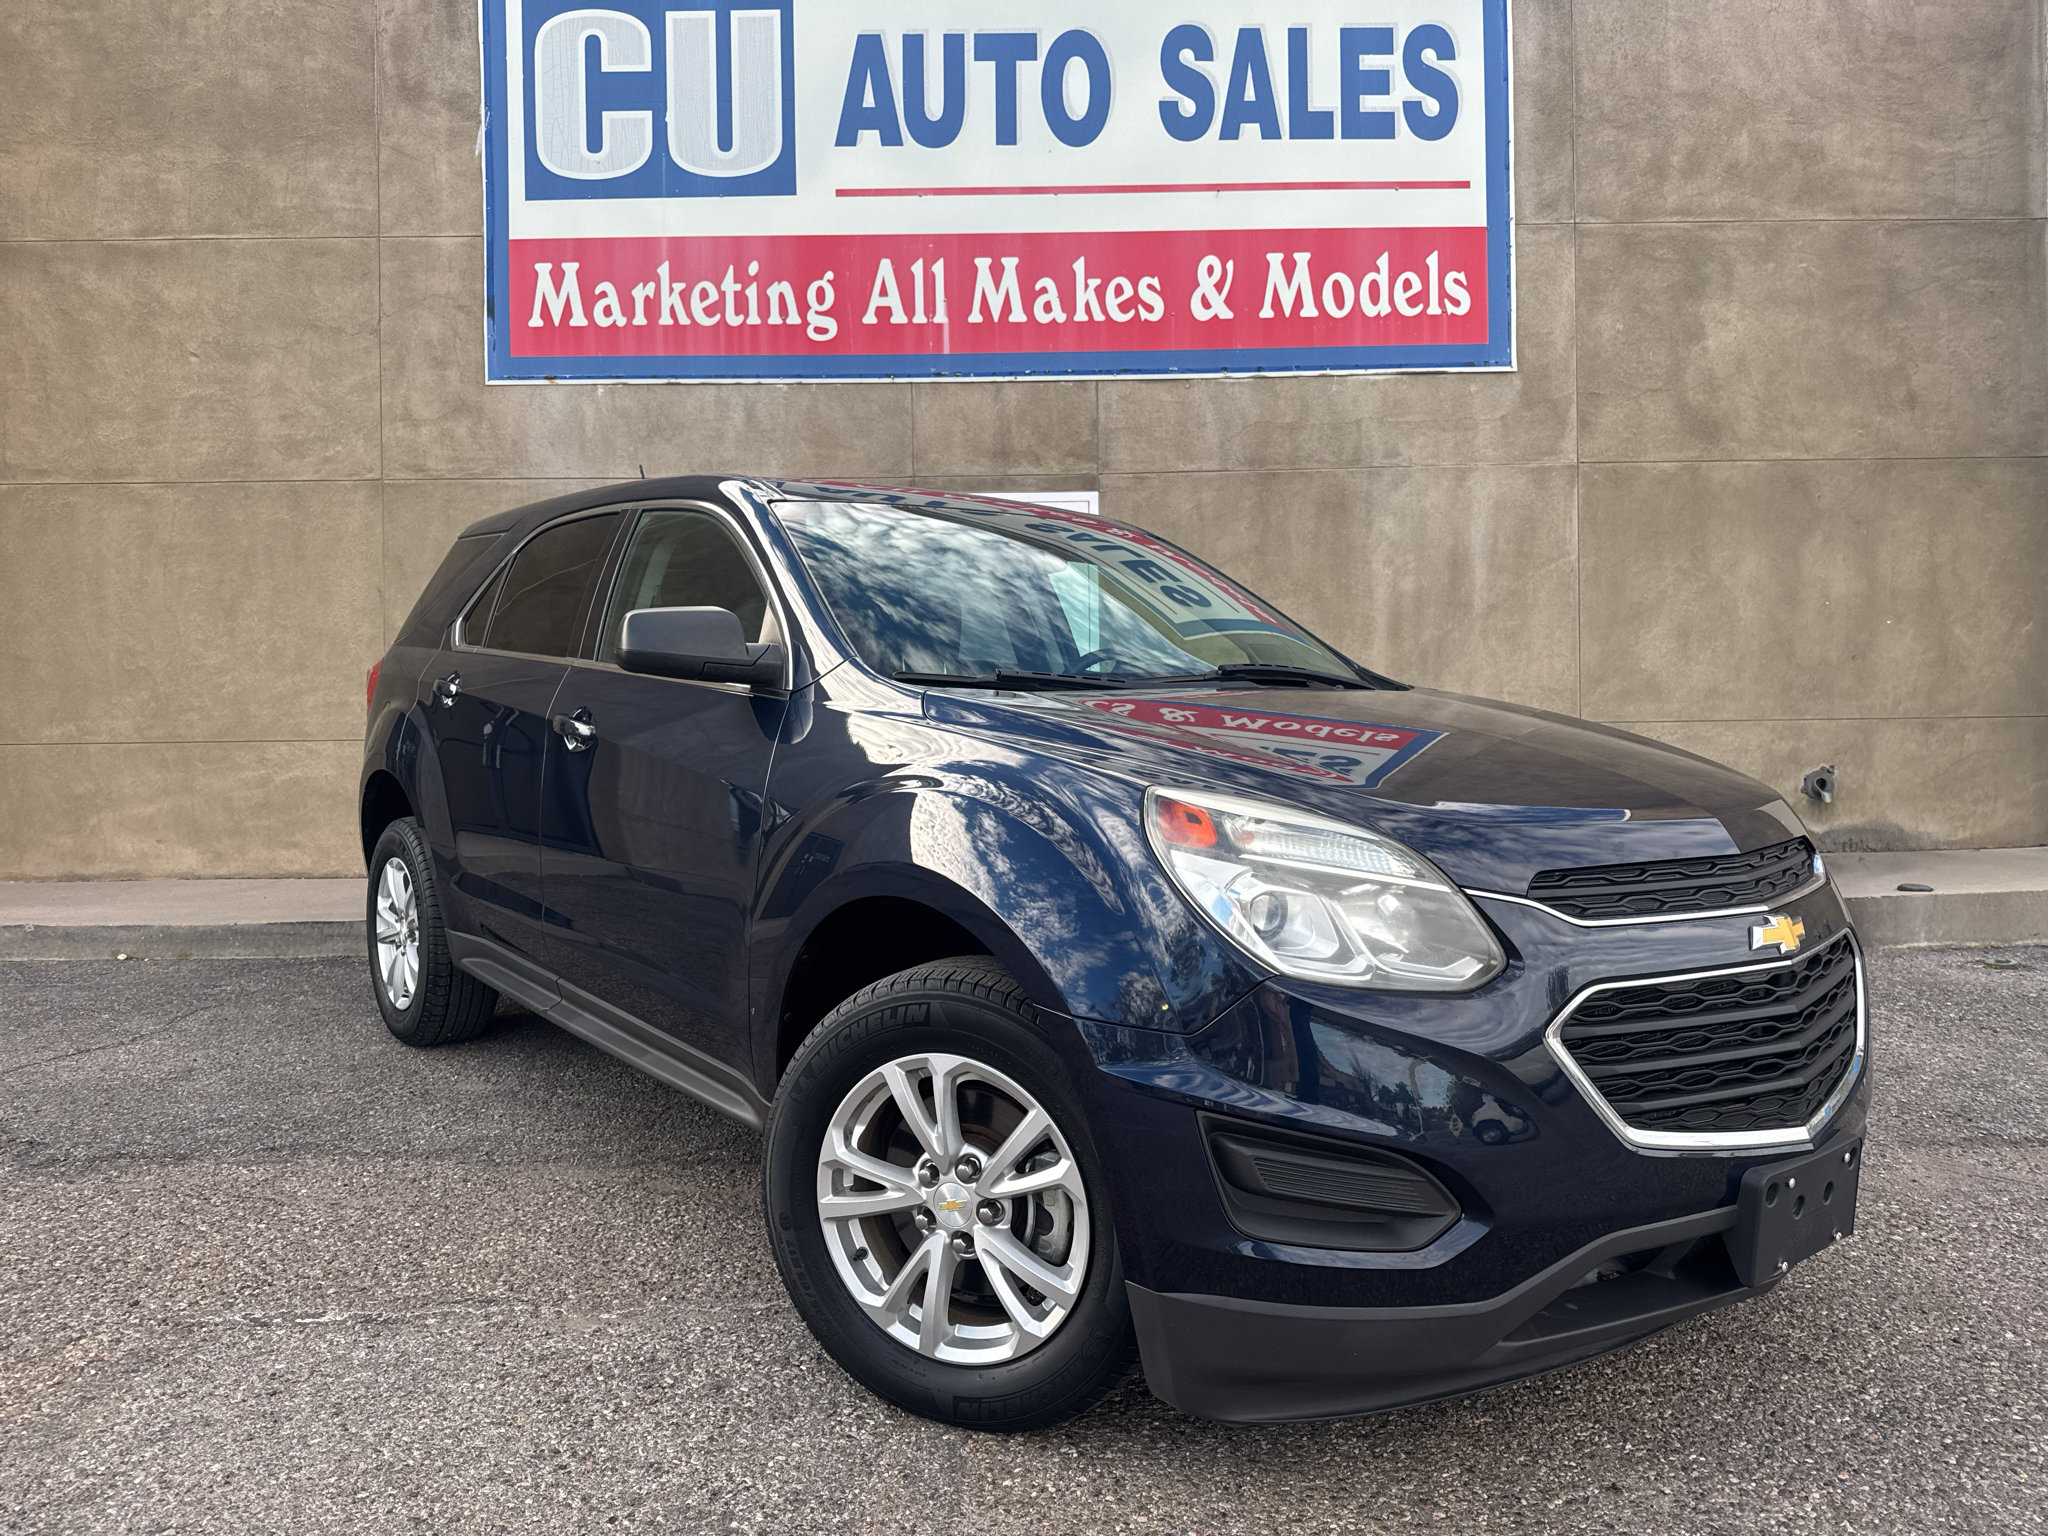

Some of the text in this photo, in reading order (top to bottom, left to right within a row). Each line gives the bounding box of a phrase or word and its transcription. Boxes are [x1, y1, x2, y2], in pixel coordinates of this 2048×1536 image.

[535, 8, 1461, 180] CU AUTO SALES
[528, 250, 1471, 342] Marketing All Makes & Models
[809, 1003, 929, 1074] MICHELIN
